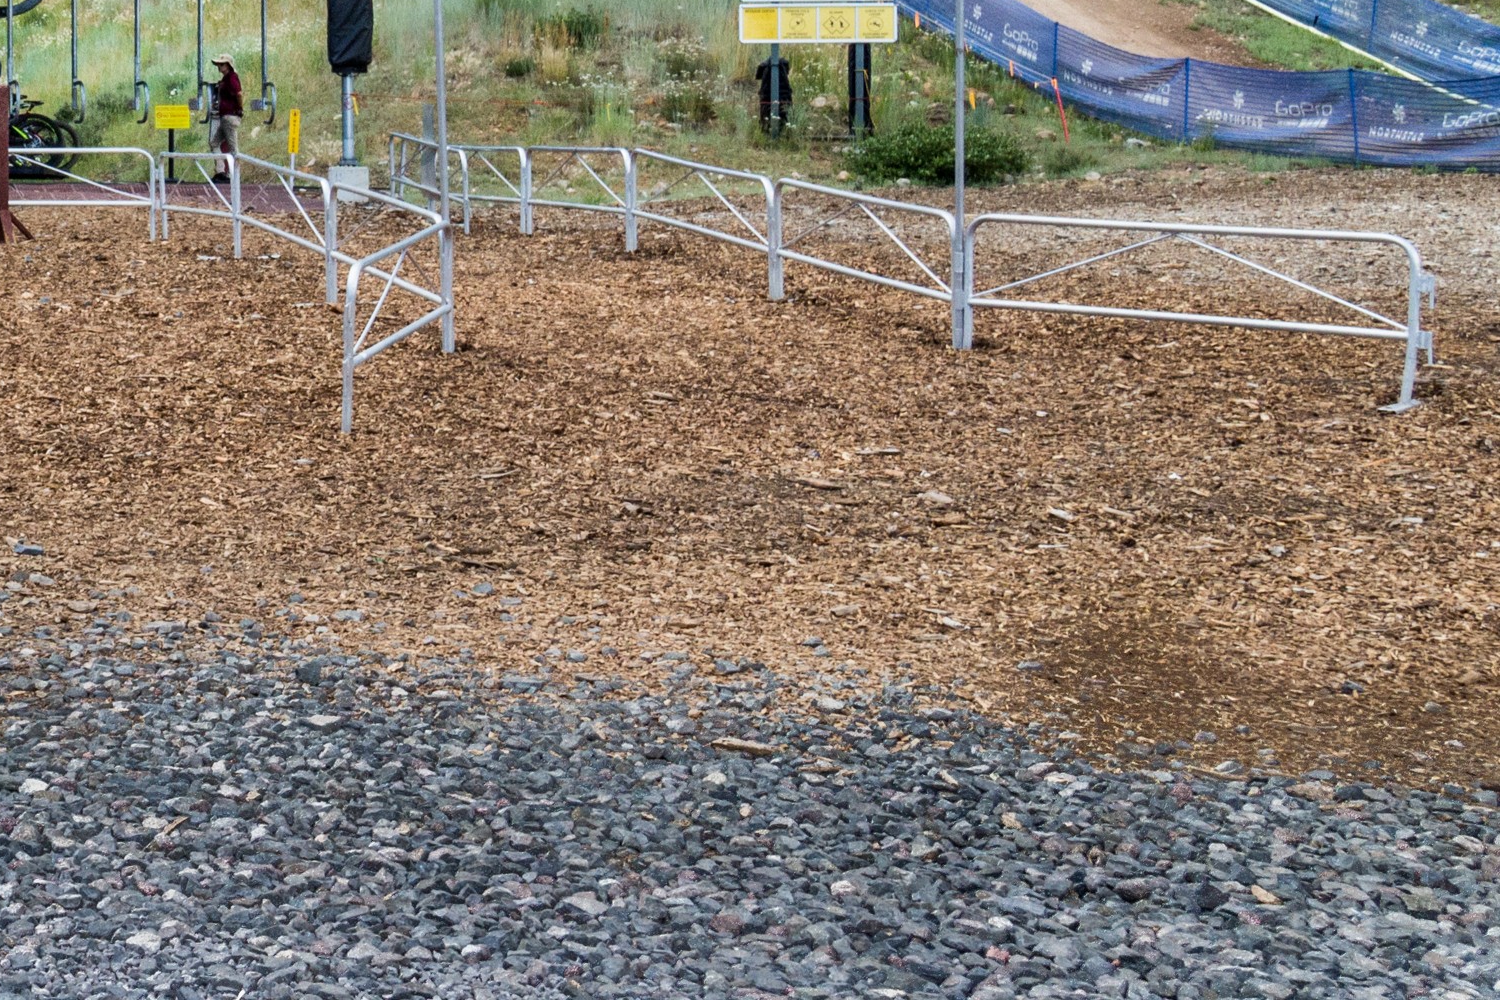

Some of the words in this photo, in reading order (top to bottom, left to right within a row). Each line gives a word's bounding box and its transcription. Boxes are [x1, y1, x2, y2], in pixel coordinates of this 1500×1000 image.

[1003, 23, 1039, 51] GoPro
[1275, 100, 1333, 117] GoPro
[1369, 125, 1424, 141] NORTHSTAR
[1442, 112, 1499, 128] GoPro
